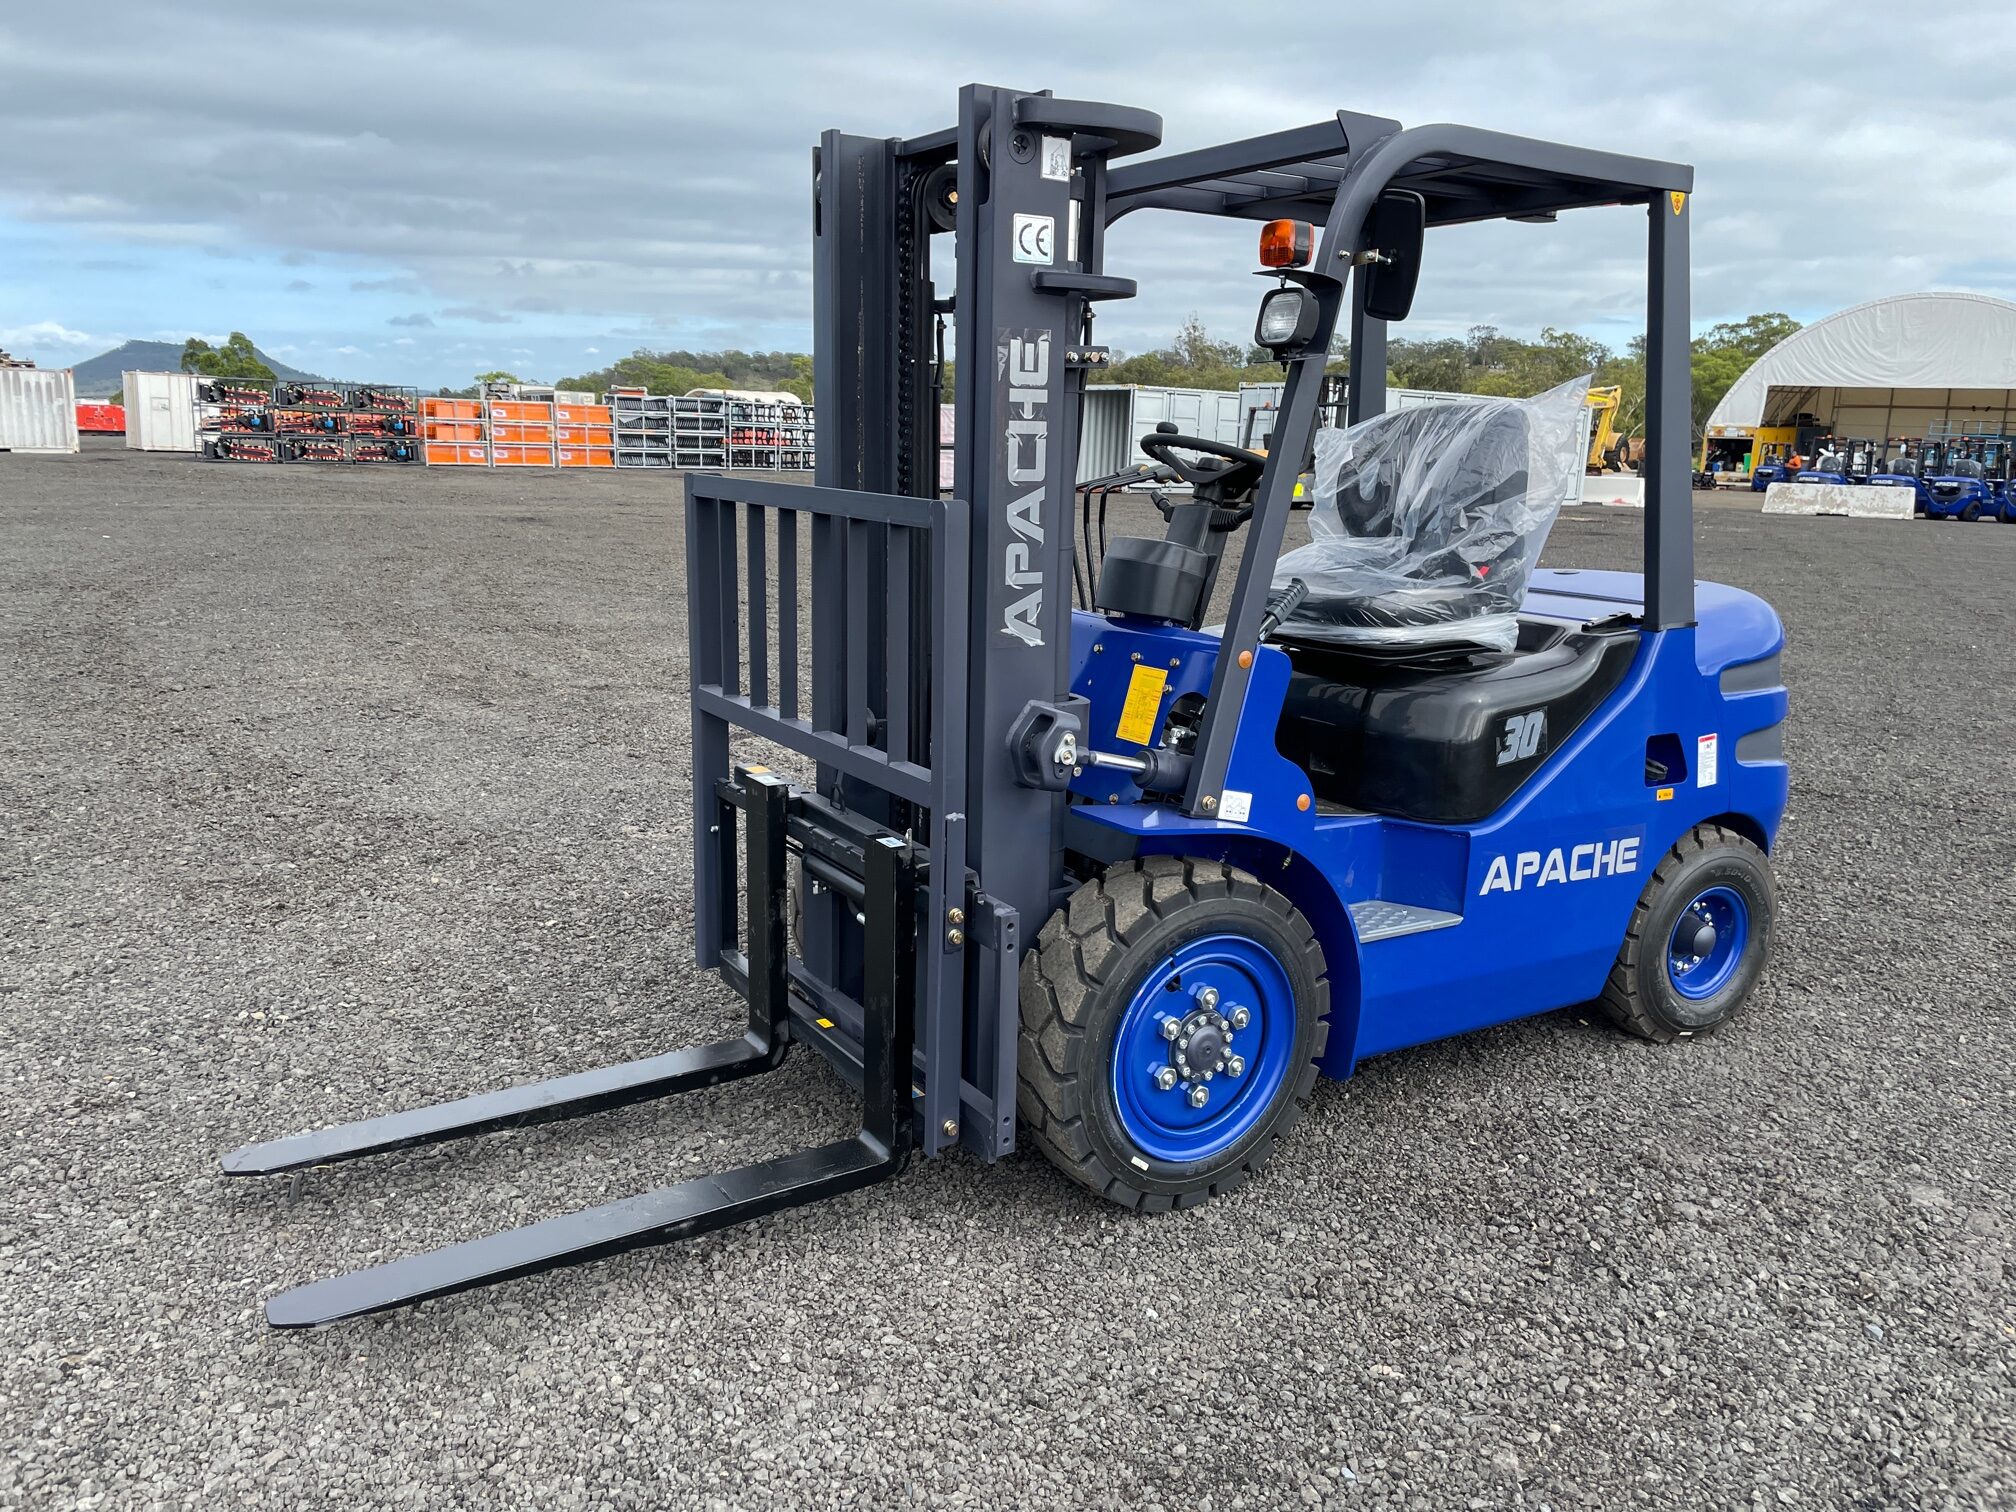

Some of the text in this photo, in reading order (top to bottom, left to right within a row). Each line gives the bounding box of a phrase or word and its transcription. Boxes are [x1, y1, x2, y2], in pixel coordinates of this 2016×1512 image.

[1019, 222, 1049, 257] CE
[1003, 337, 1050, 646] APACHE
[1497, 710, 1545, 764] 30
[1479, 836, 1641, 896] APACHE
